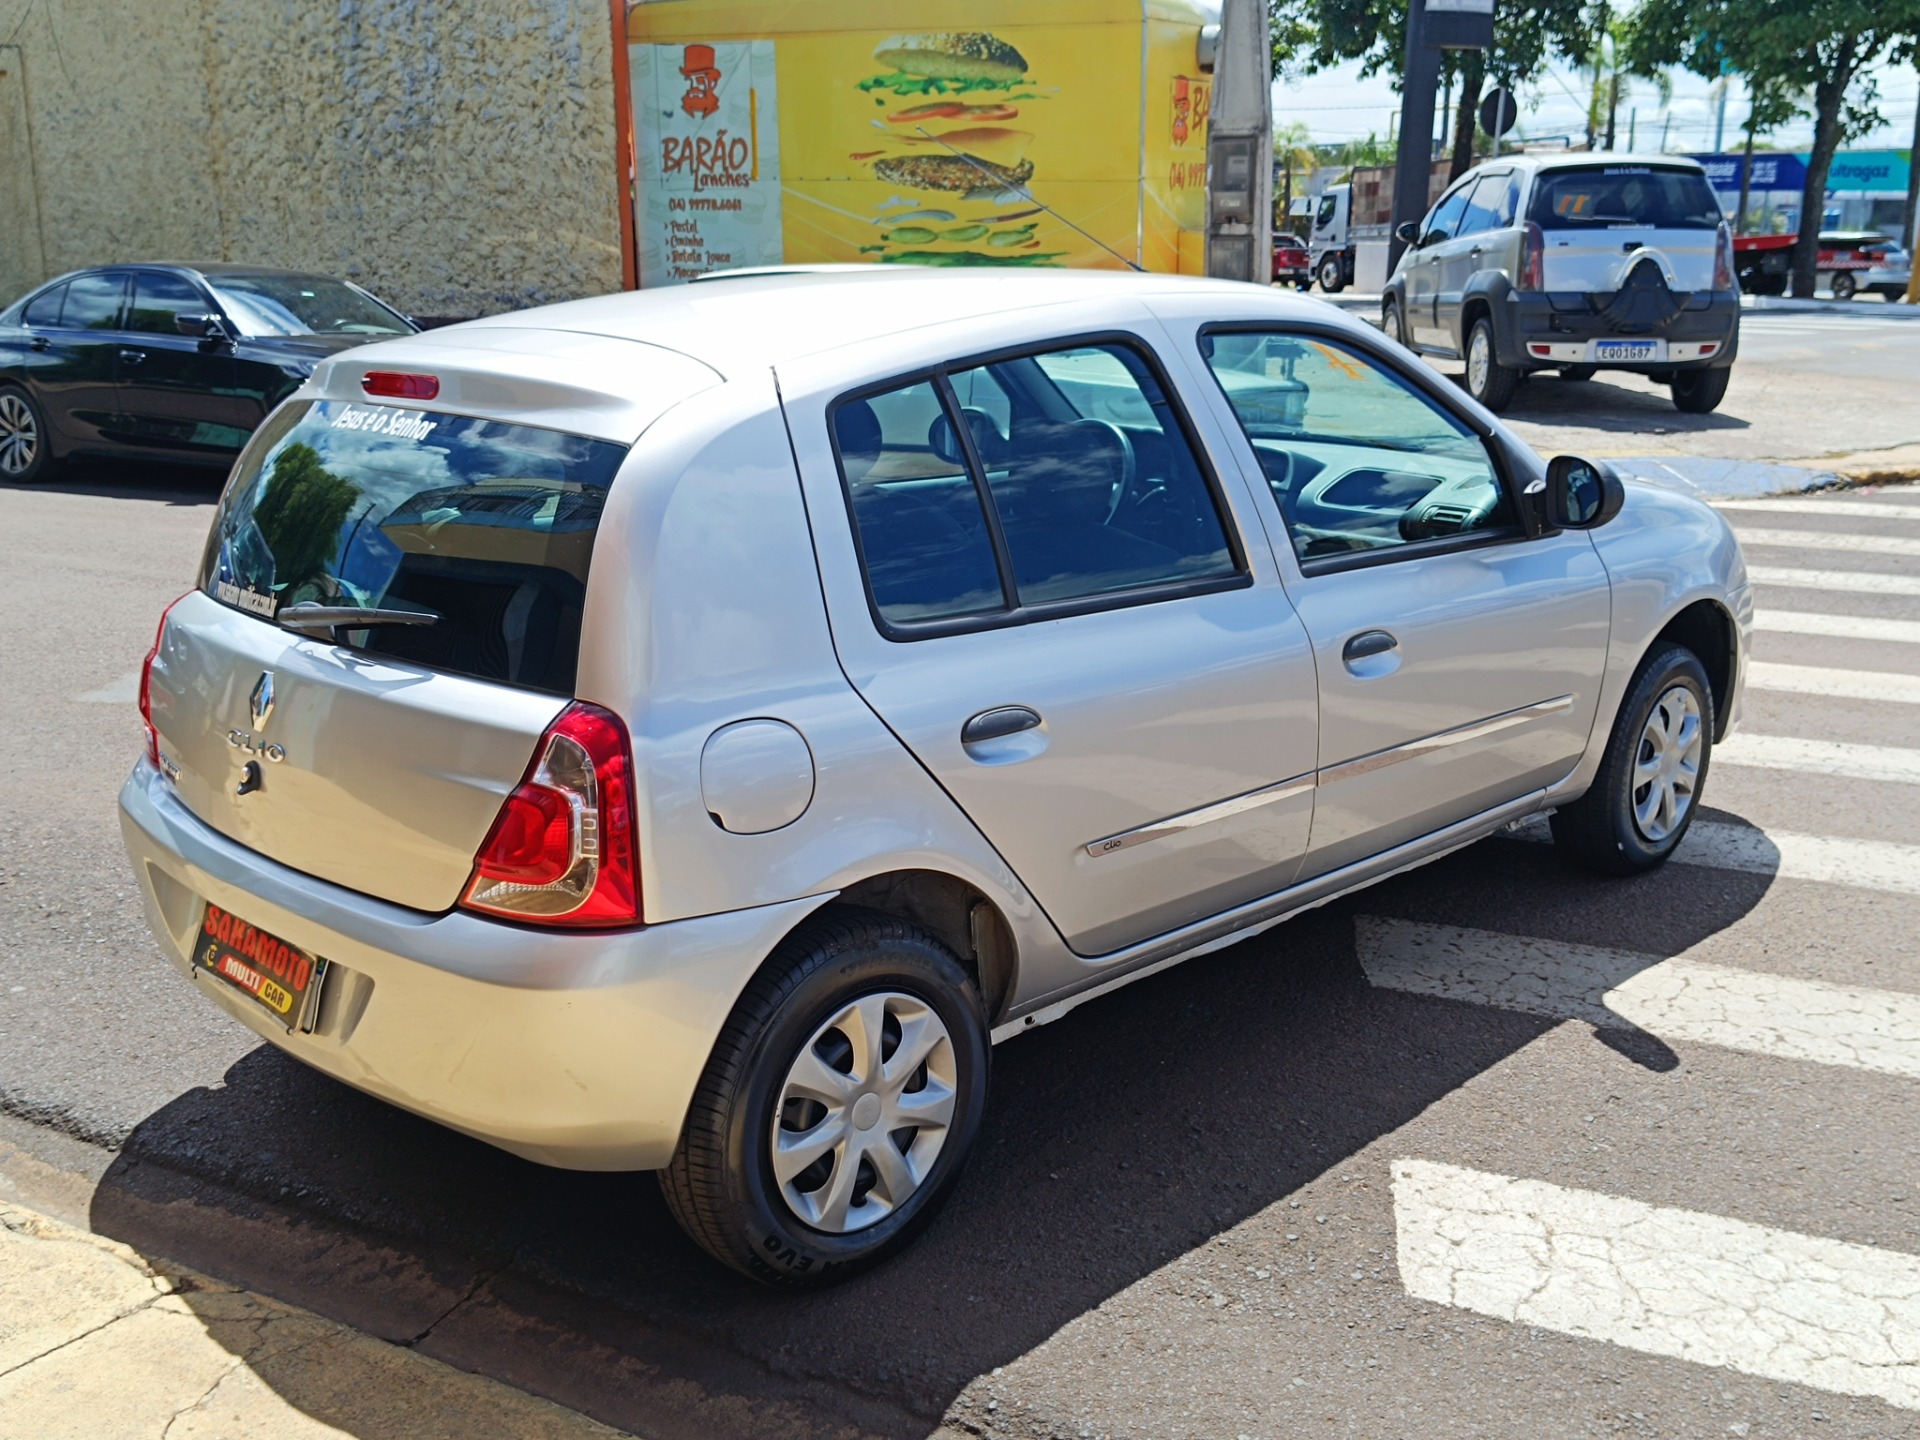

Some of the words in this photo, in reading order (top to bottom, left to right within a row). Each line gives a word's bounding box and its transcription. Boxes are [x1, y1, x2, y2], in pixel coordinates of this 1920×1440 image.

[662, 129, 748, 175] BARÃO
[694, 167, 750, 192] Lanches
[1830, 163, 1890, 182] ultragaz
[670, 219, 699, 234] Pastel
[331, 404, 370, 431] Jesus
[362, 406, 385, 431] é
[372, 413, 389, 432] o
[382, 408, 438, 441] Senhor
[226, 729, 286, 763] CLIO
[204, 905, 310, 992] SAKAMOTO
[225, 957, 261, 990] MULTI
[264, 982, 286, 1008] CAR
[764, 1234, 816, 1273] EVO
